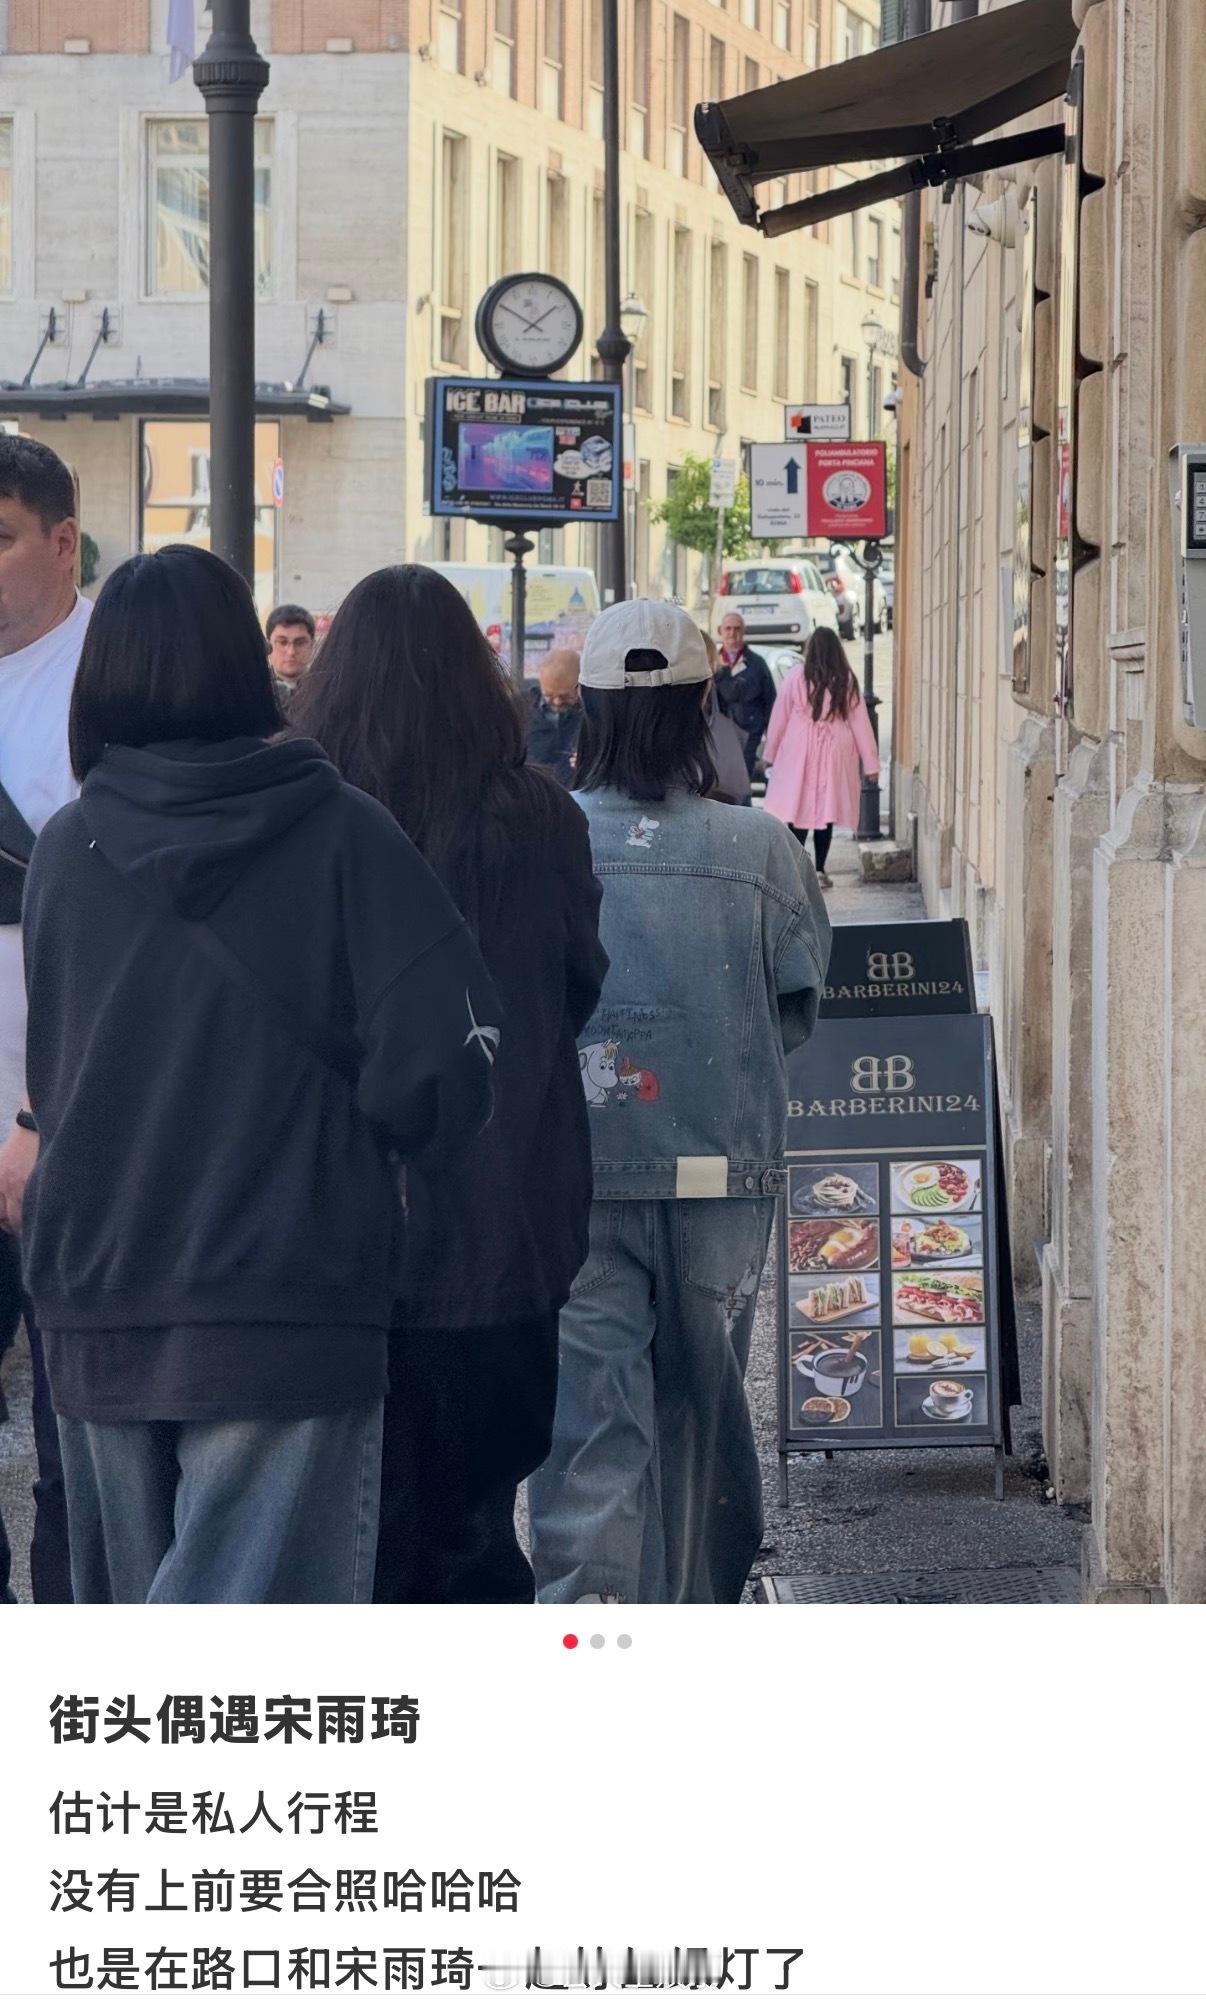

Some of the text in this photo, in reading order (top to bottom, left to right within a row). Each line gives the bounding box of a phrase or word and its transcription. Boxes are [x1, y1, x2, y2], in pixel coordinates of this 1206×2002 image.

[446, 388, 526, 414] ICE BAR
[822, 980, 965, 999] BARBERINI24
[787, 1094, 981, 1118] BARBERINI24
